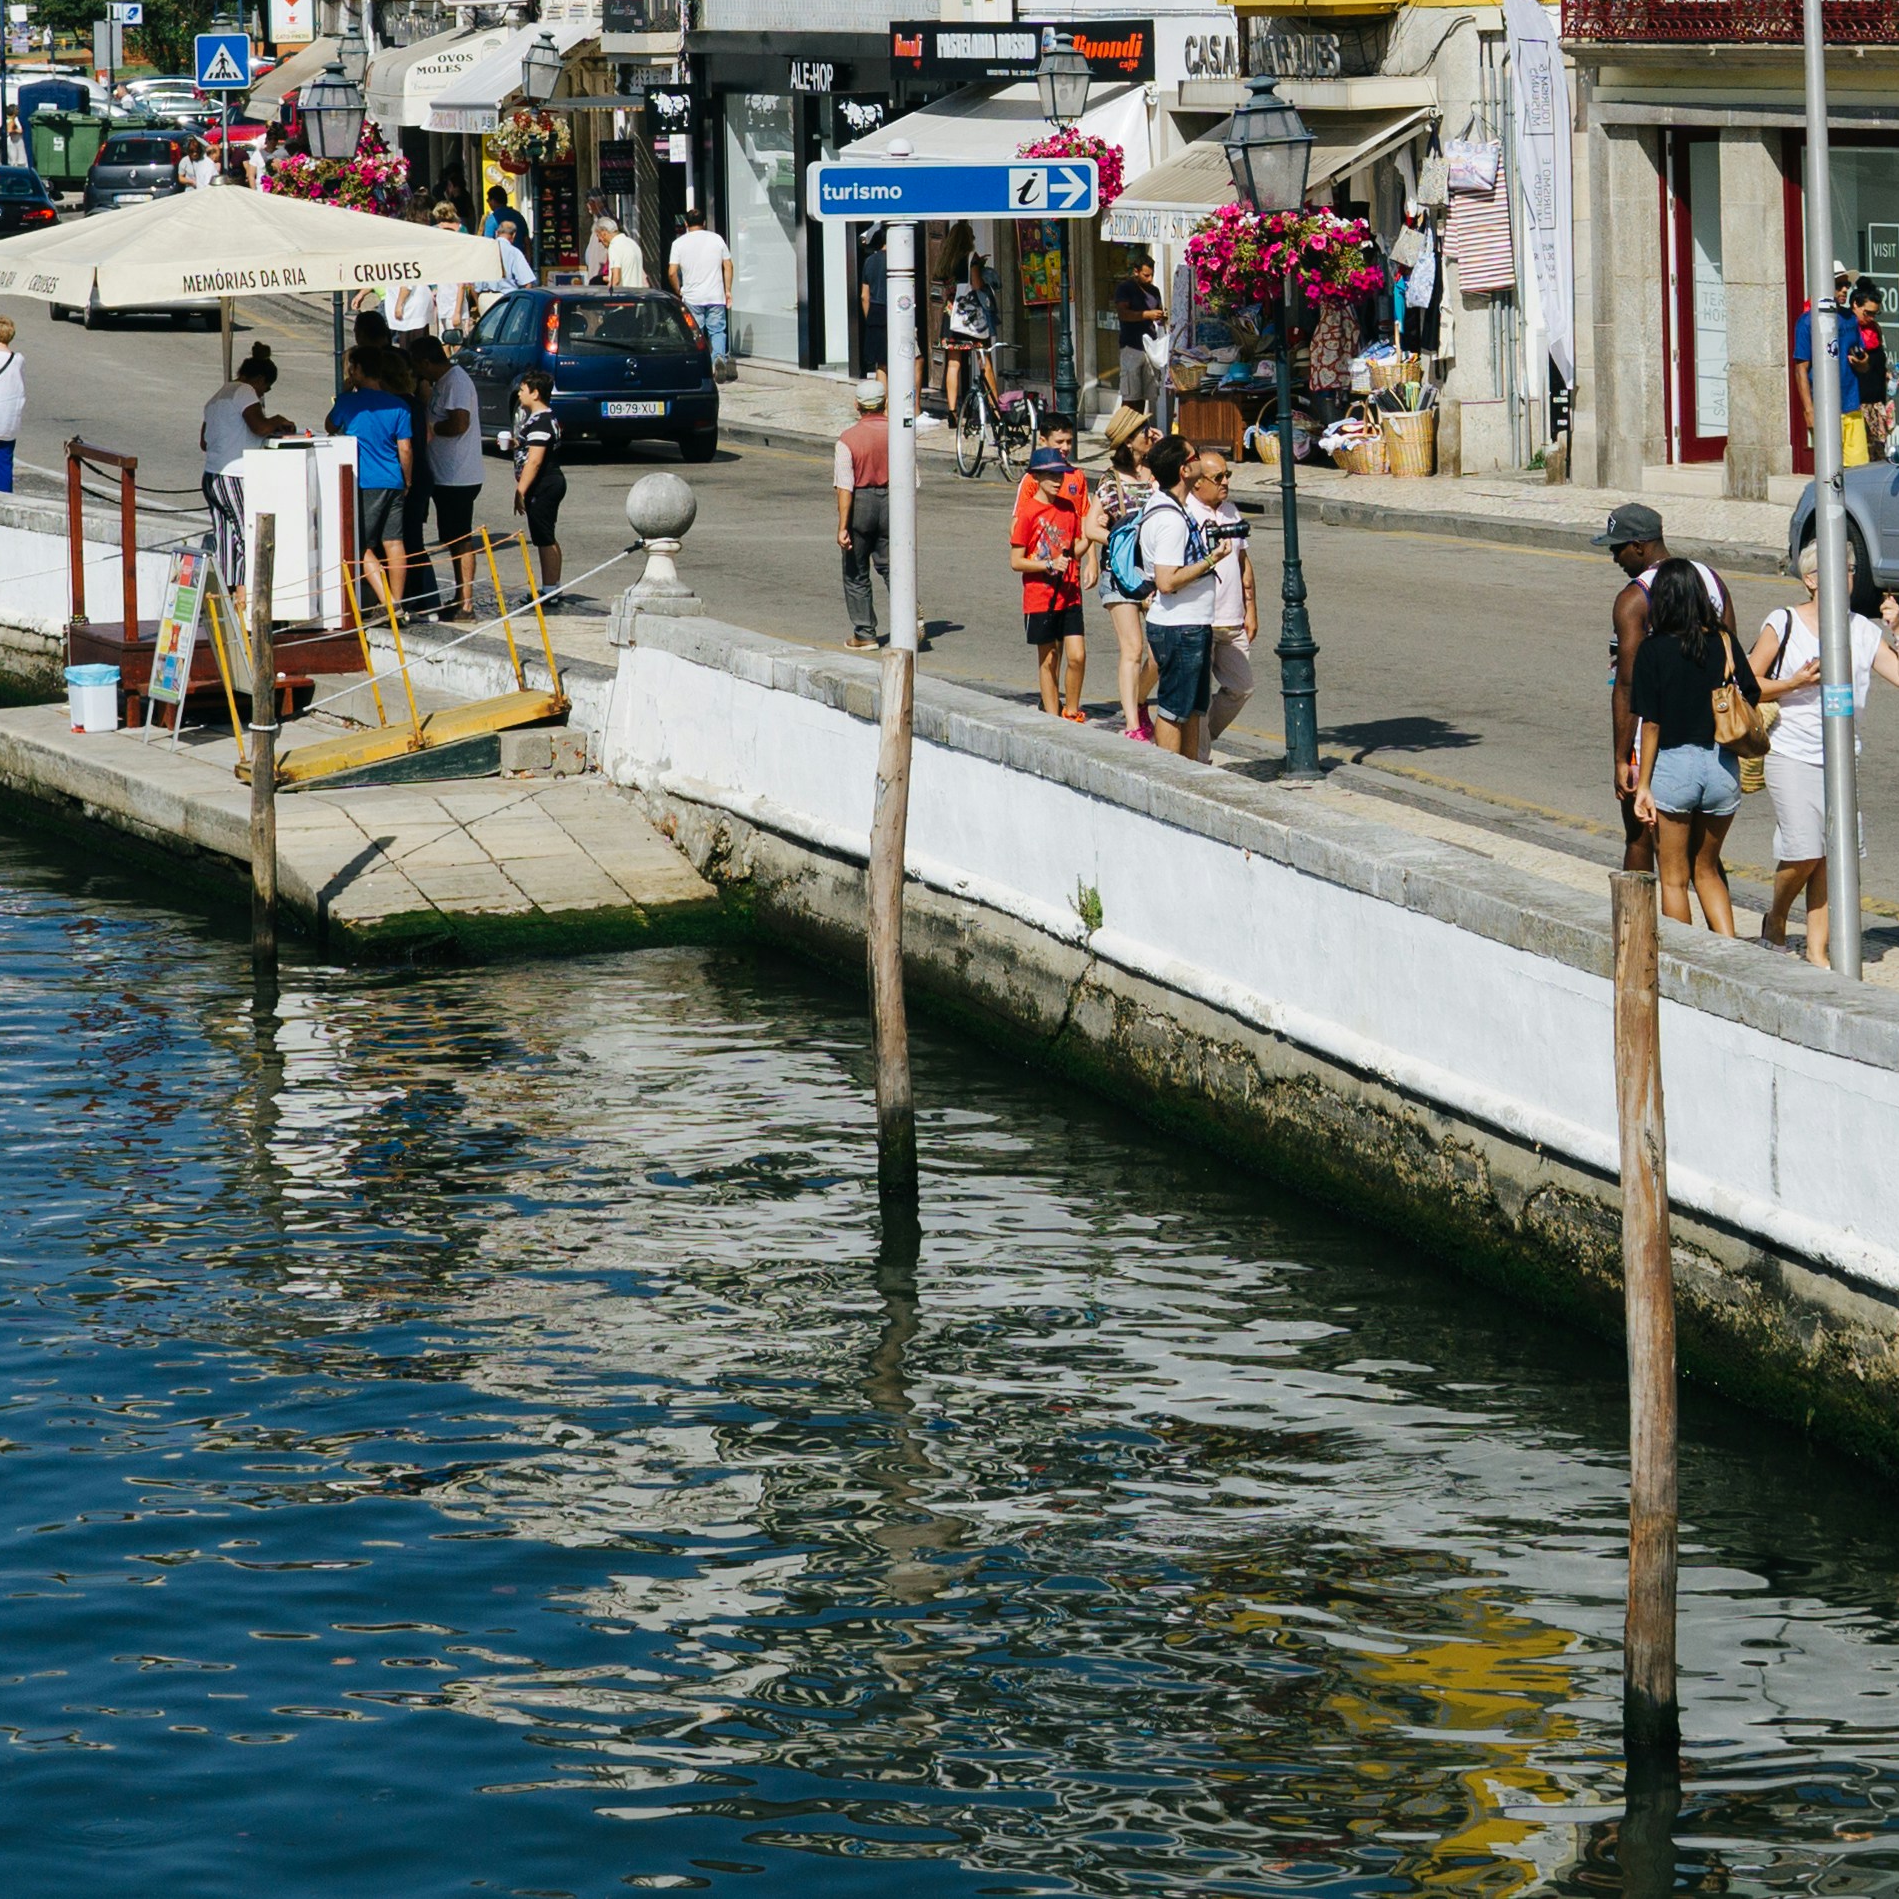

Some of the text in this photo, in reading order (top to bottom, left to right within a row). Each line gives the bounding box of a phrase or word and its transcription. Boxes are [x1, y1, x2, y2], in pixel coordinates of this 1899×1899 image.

[437, 53, 474, 64] OVOS
[1184, 34, 1238, 76] CASA
[416, 63, 462, 76] MOLES
[822, 182, 903, 201] turismo
[1873, 243, 1897, 258] VISIT
[28, 274, 60, 295] CRUISES
[182, 267, 257, 293] MEMÓRIAS
[260, 269, 281, 289] DA
[282, 267, 308, 287] RIA
[354, 261, 422, 283] CRUISES
